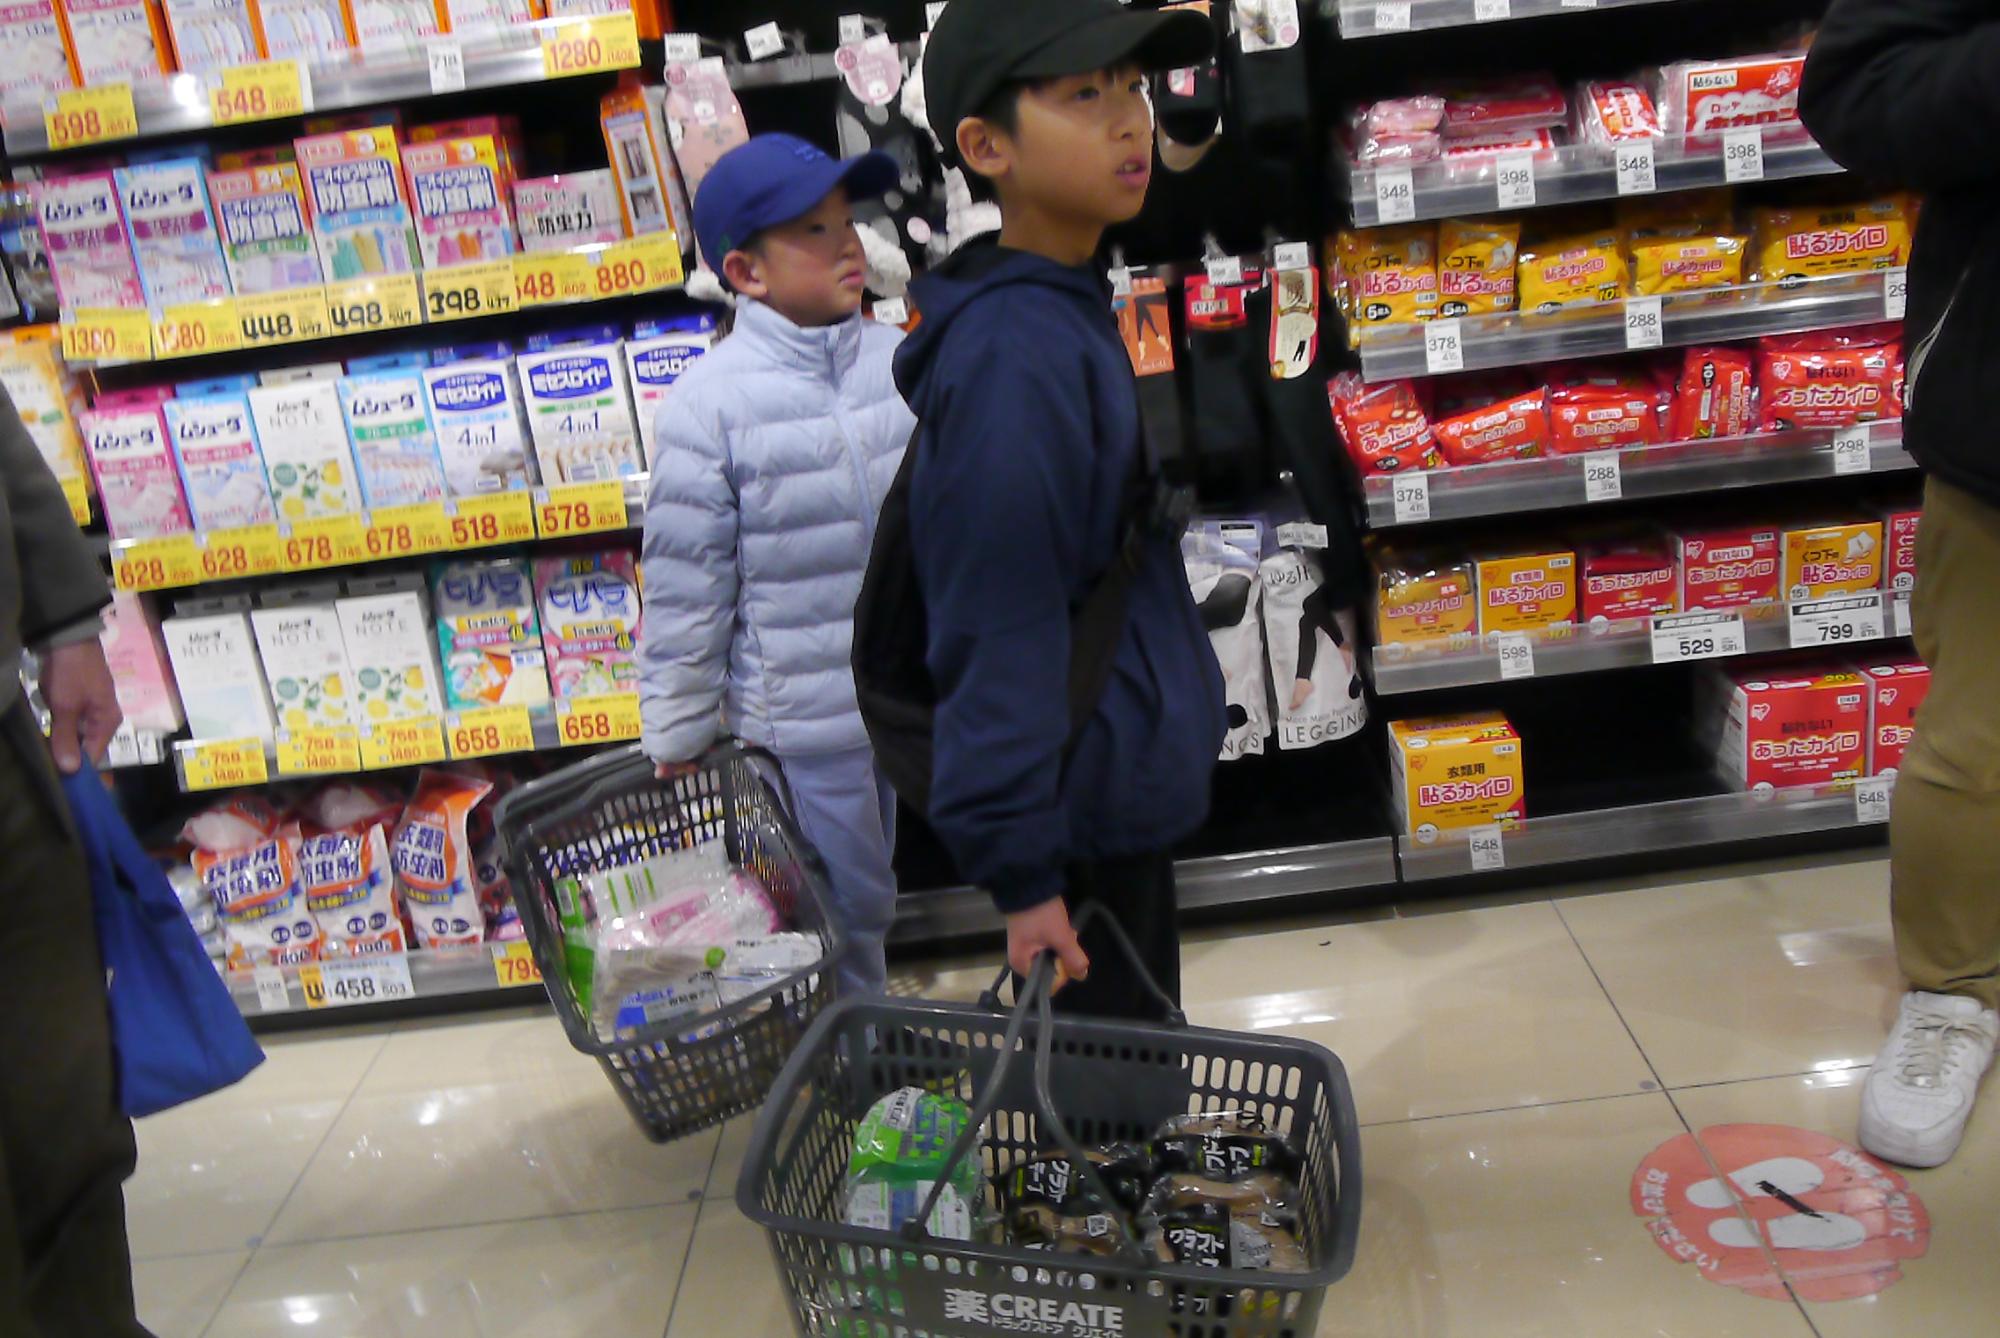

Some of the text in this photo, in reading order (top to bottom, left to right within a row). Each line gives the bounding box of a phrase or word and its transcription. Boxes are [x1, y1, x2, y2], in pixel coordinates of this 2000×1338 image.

[549, 38, 602, 71] 1280
[216, 86, 266, 120] 548
[53, 108, 102, 145] 598
[1619, 156, 1649, 171] 348
[1727, 144, 1757, 159] 398
[1500, 169, 1529, 184] 398
[1380, 184, 1409, 200] 348
[1788, 225, 1887, 258] 貼るカイロ
[596, 259, 646, 294] 880
[1441, 271, 1514, 295] 貼るカイロ
[1544, 258, 1606, 283] 貼るカイロ
[1364, 271, 1436, 296] 貼るカイロ
[242, 314, 293, 340] 448
[331, 302, 383, 330] 498
[1628, 313, 1657, 328] 288
[1428, 337, 1457, 351] 378
[1836, 440, 1865, 453] 298
[1588, 467, 1616, 481] 288
[1396, 489, 1424, 502] 378
[452, 512, 498, 544] 518
[543, 501, 591, 533] 578
[287, 536, 333, 565] 678
[367, 524, 412, 554] 678
[120, 560, 165, 589] 628
[203, 548, 248, 576] 628
[1689, 558, 1775, 584] あったカイロ
[1801, 563, 1871, 585] 貼るカイロ
[1589, 568, 1672, 593] あったカイロ
[1489, 583, 1566, 607] 貼るカイロ
[1818, 623, 1854, 642] 799
[1501, 646, 1528, 660] 598
[1679, 638, 1715, 656] 529
[566, 713, 610, 741] 658
[456, 726, 500, 754] 658
[1752, 731, 1860, 761] あったカイロ
[1419, 776, 1514, 808] 貼るカイロ
[1858, 791, 1886, 805] 648
[1471, 839, 1499, 852] 648
[336, 976, 375, 999] 458
[990, 1292, 1124, 1331] CREATE
